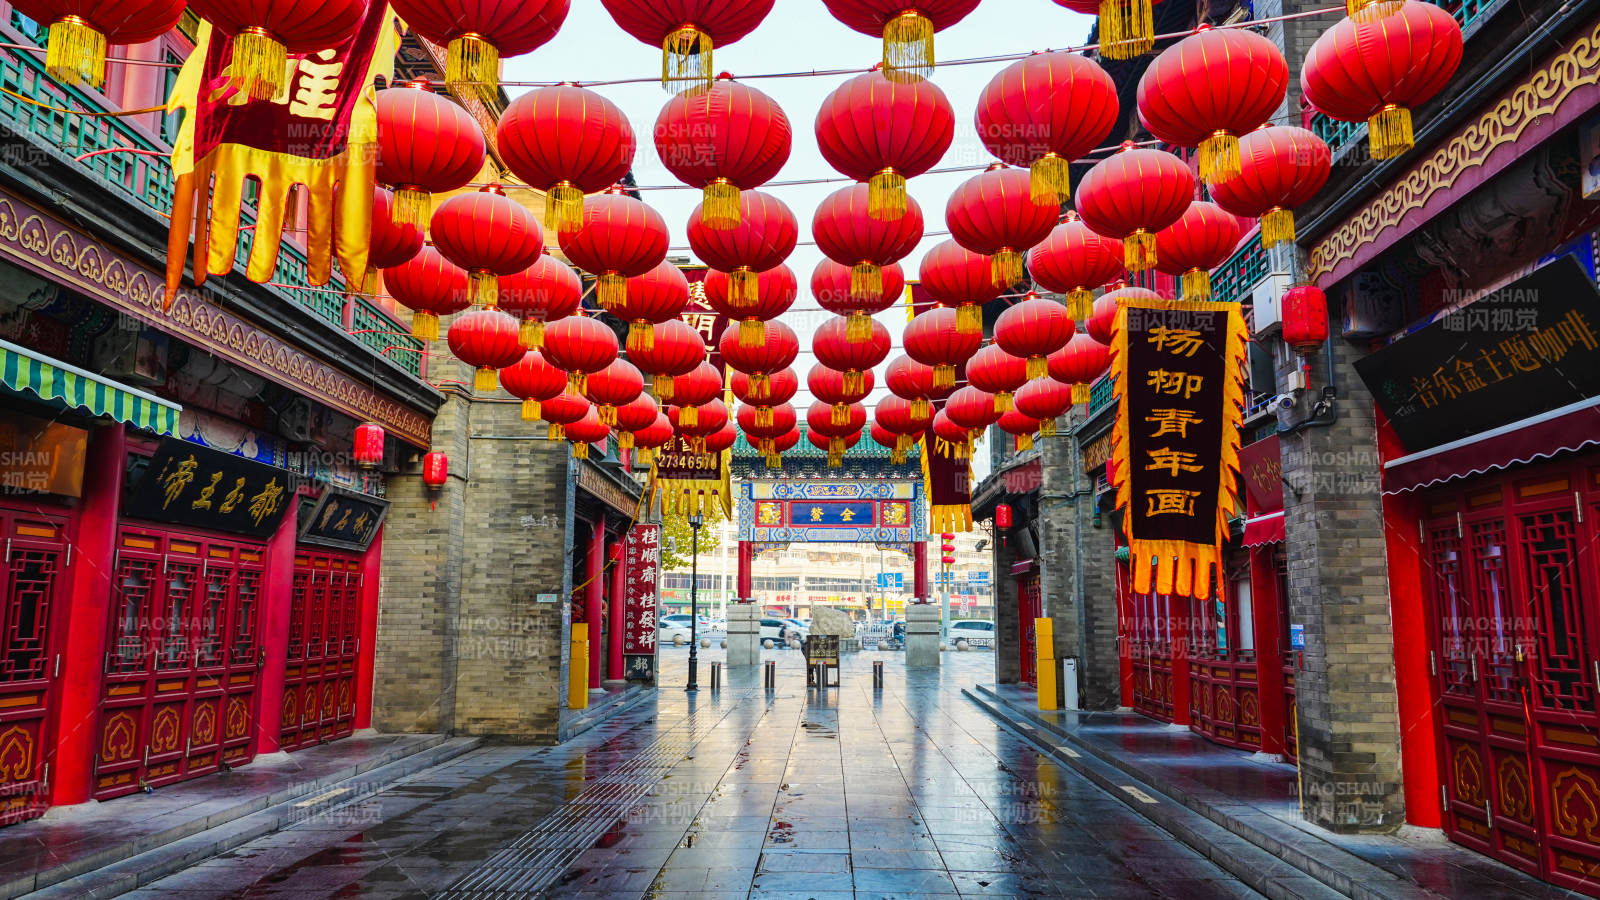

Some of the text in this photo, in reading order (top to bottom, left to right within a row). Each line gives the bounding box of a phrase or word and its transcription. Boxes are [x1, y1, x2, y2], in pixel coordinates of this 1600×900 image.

[1410, 309, 1599, 409] 音乐盒主题咖啡
[1144, 324, 1205, 518] 杨柳青年画
[638, 592, 657, 650] 桂發祥
